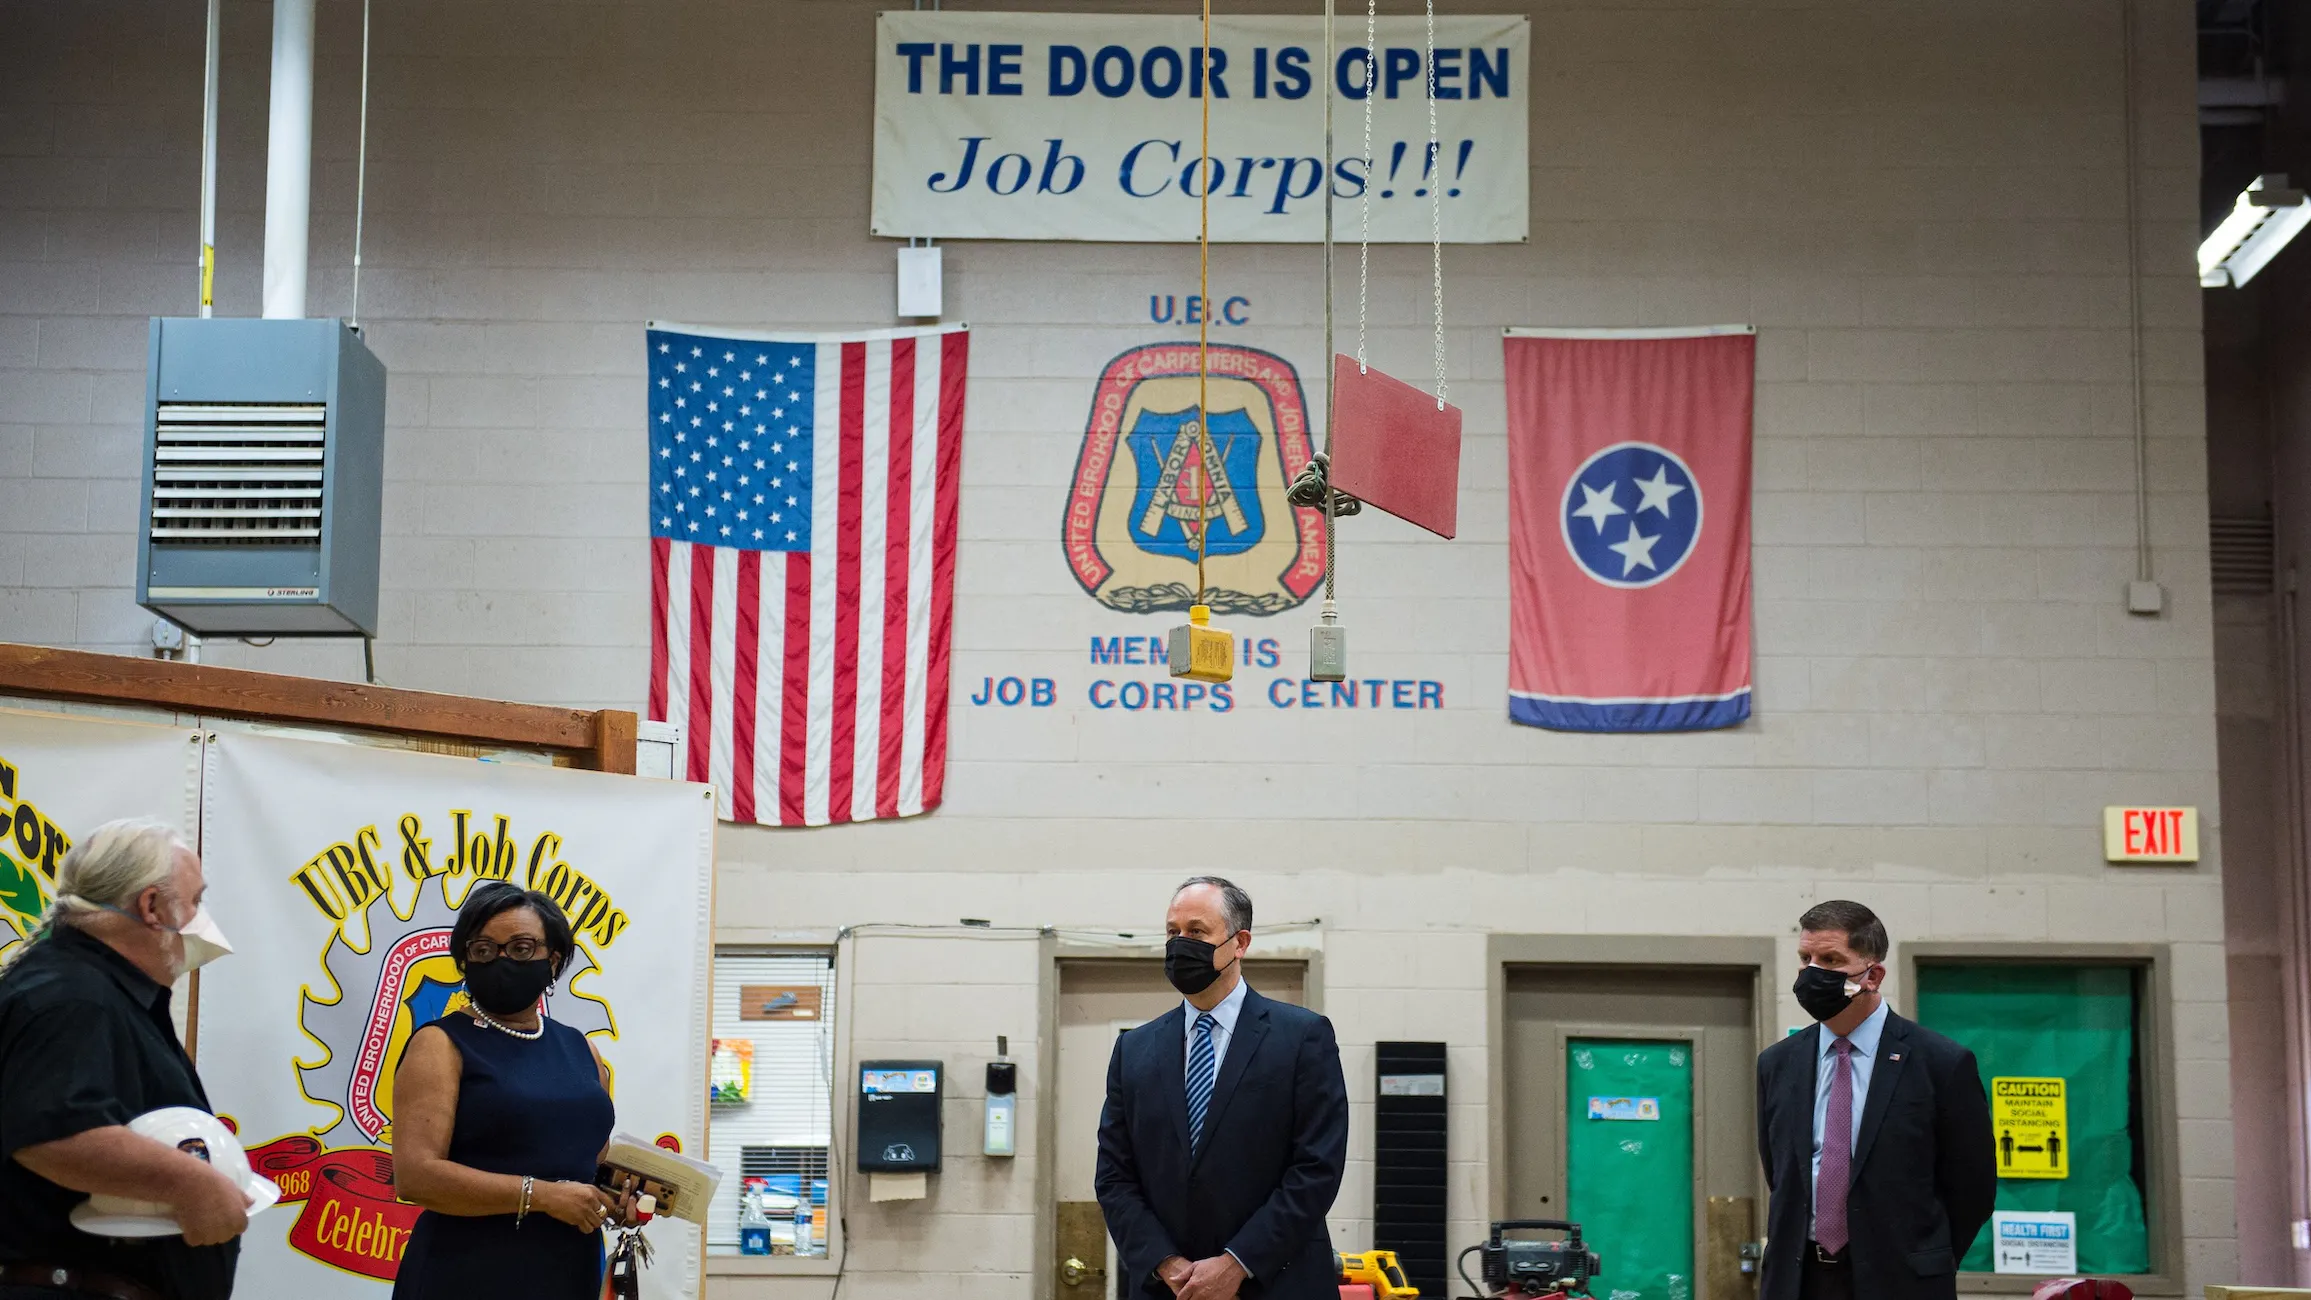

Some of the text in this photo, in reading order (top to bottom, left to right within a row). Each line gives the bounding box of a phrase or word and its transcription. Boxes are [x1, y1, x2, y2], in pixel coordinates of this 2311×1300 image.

[896, 43, 1510, 100] THE DOOR IS OPEN
[927, 137, 1474, 215] Job Corps!!!
[1151, 295, 1251, 326] U.B.C
[1071, 502, 1101, 583] UNITED
[1115, 362, 1135, 388] OF
[1090, 637, 1280, 669] MEMIS
[971, 676, 1444, 713] JOB CORPS CENTER
[2124, 810, 2184, 855] EXIT
[296, 812, 627, 946] UBC & Job Corps
[404, 943, 419, 957] OF
[363, 953, 405, 1072] BROTHERHOOD
[355, 1074, 379, 1132] UNITED
[1998, 1082, 2060, 1096] CAUTION
[2005, 1099, 2053, 1107] MAINTAIN
[1999, 1119, 2060, 1127] DISTANCING
[2010, 1109, 2046, 1117] SOCIAL
[2001, 1223, 2067, 1238] HEALTH FIRST
